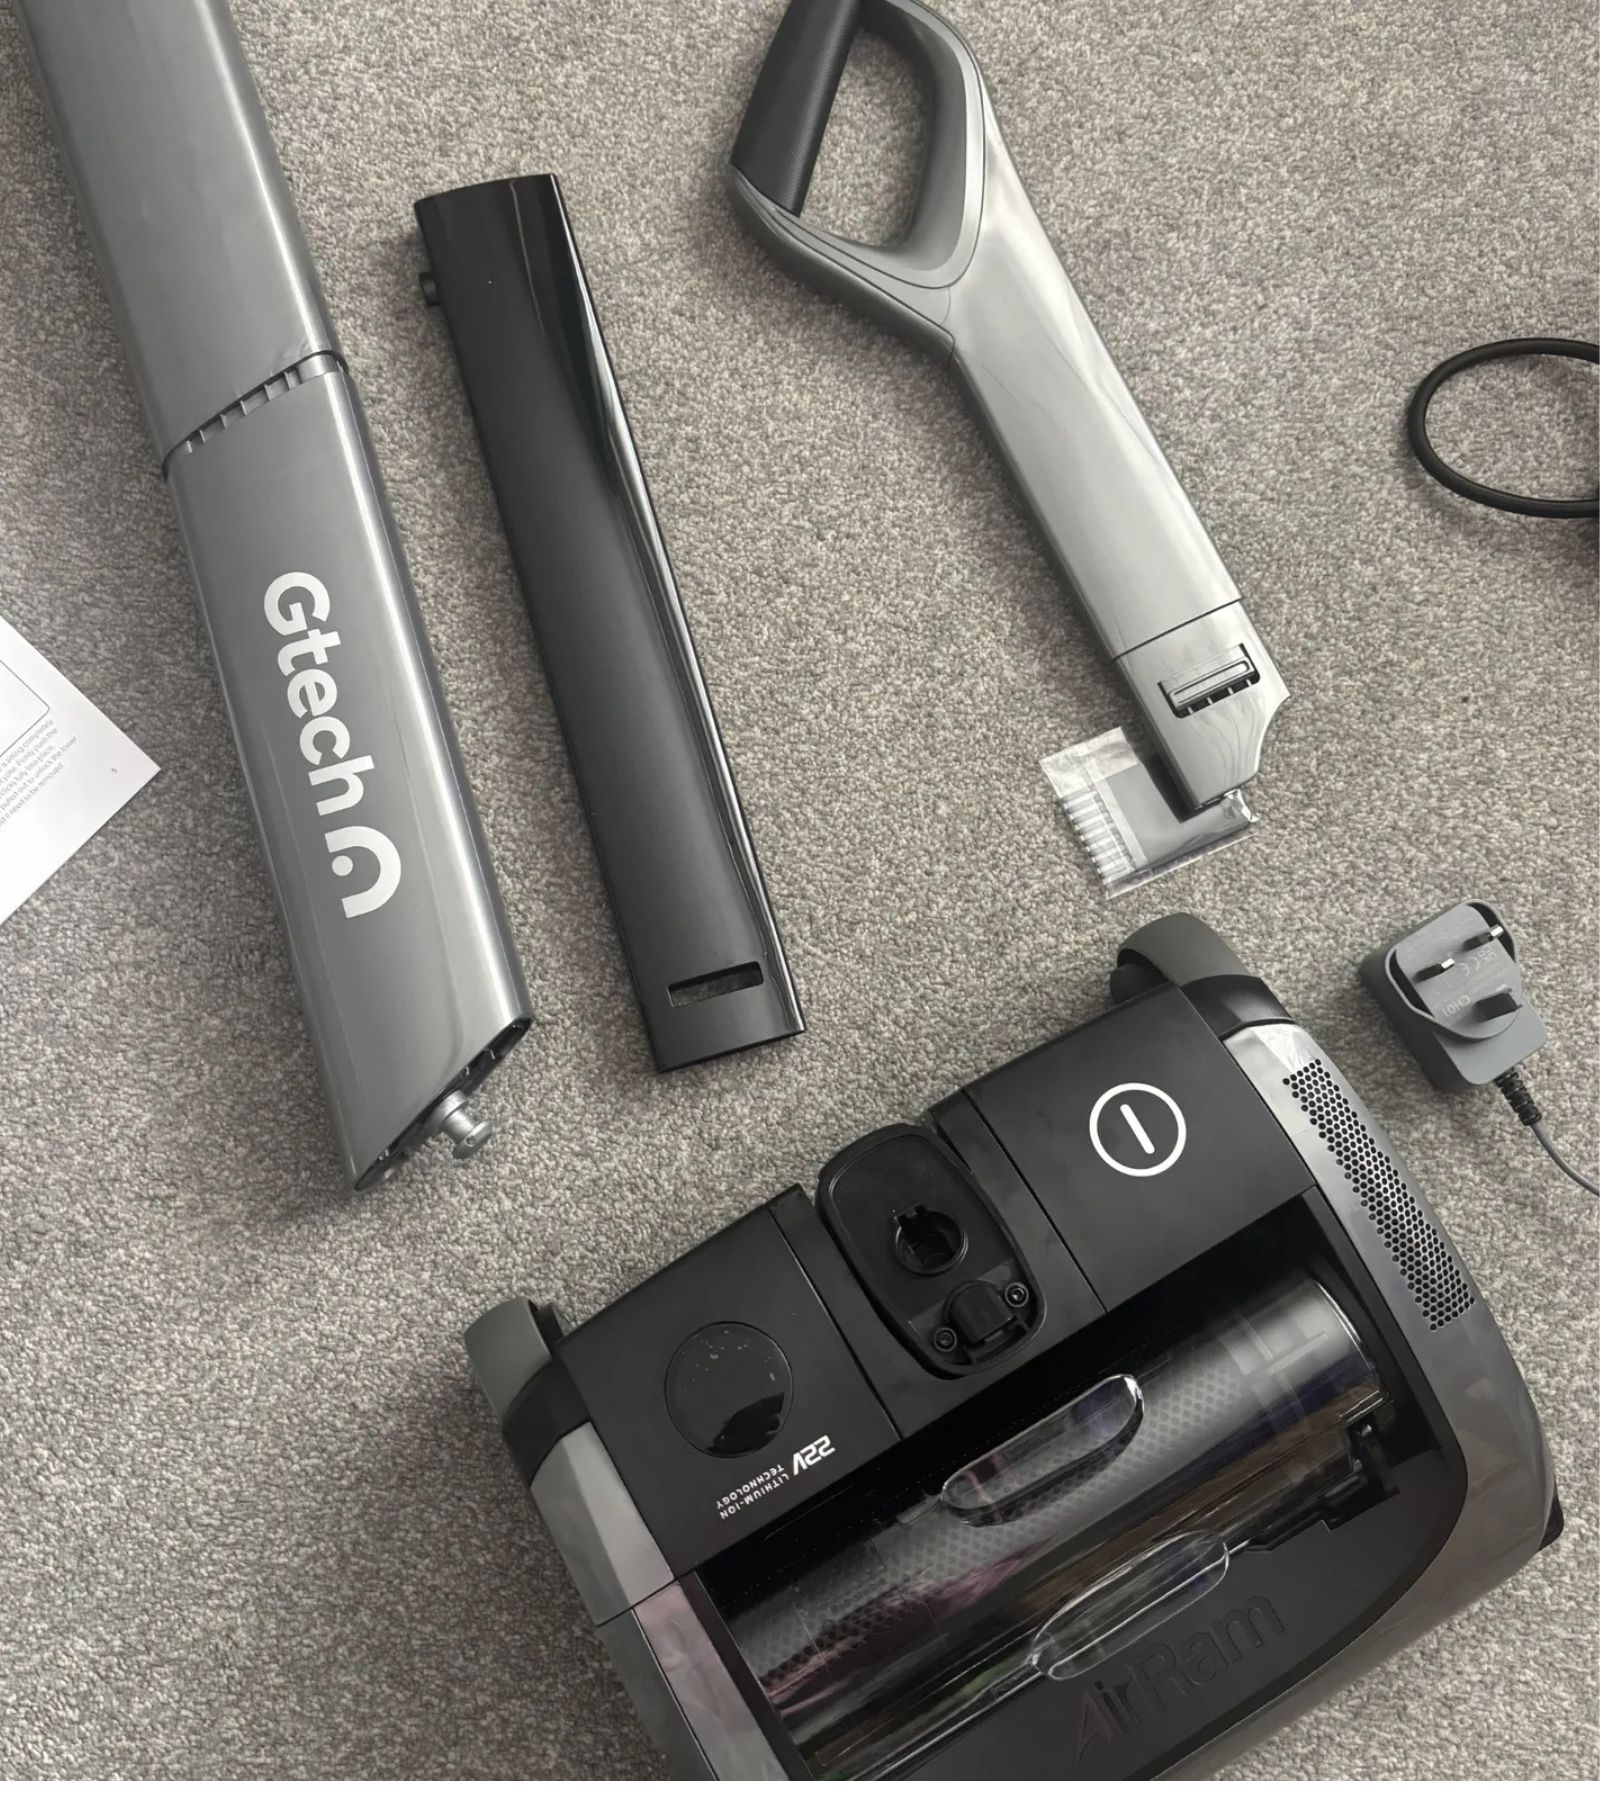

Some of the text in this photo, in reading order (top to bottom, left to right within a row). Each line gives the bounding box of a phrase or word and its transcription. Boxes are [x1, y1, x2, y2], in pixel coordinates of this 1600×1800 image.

[263, 571, 375, 817] Gtech
[716, 1463, 785, 1510] TECHNOLOGY
[719, 1434, 836, 1520] 22V LITHIUM-ION
[1076, 1595, 1287, 1765] AirRam
